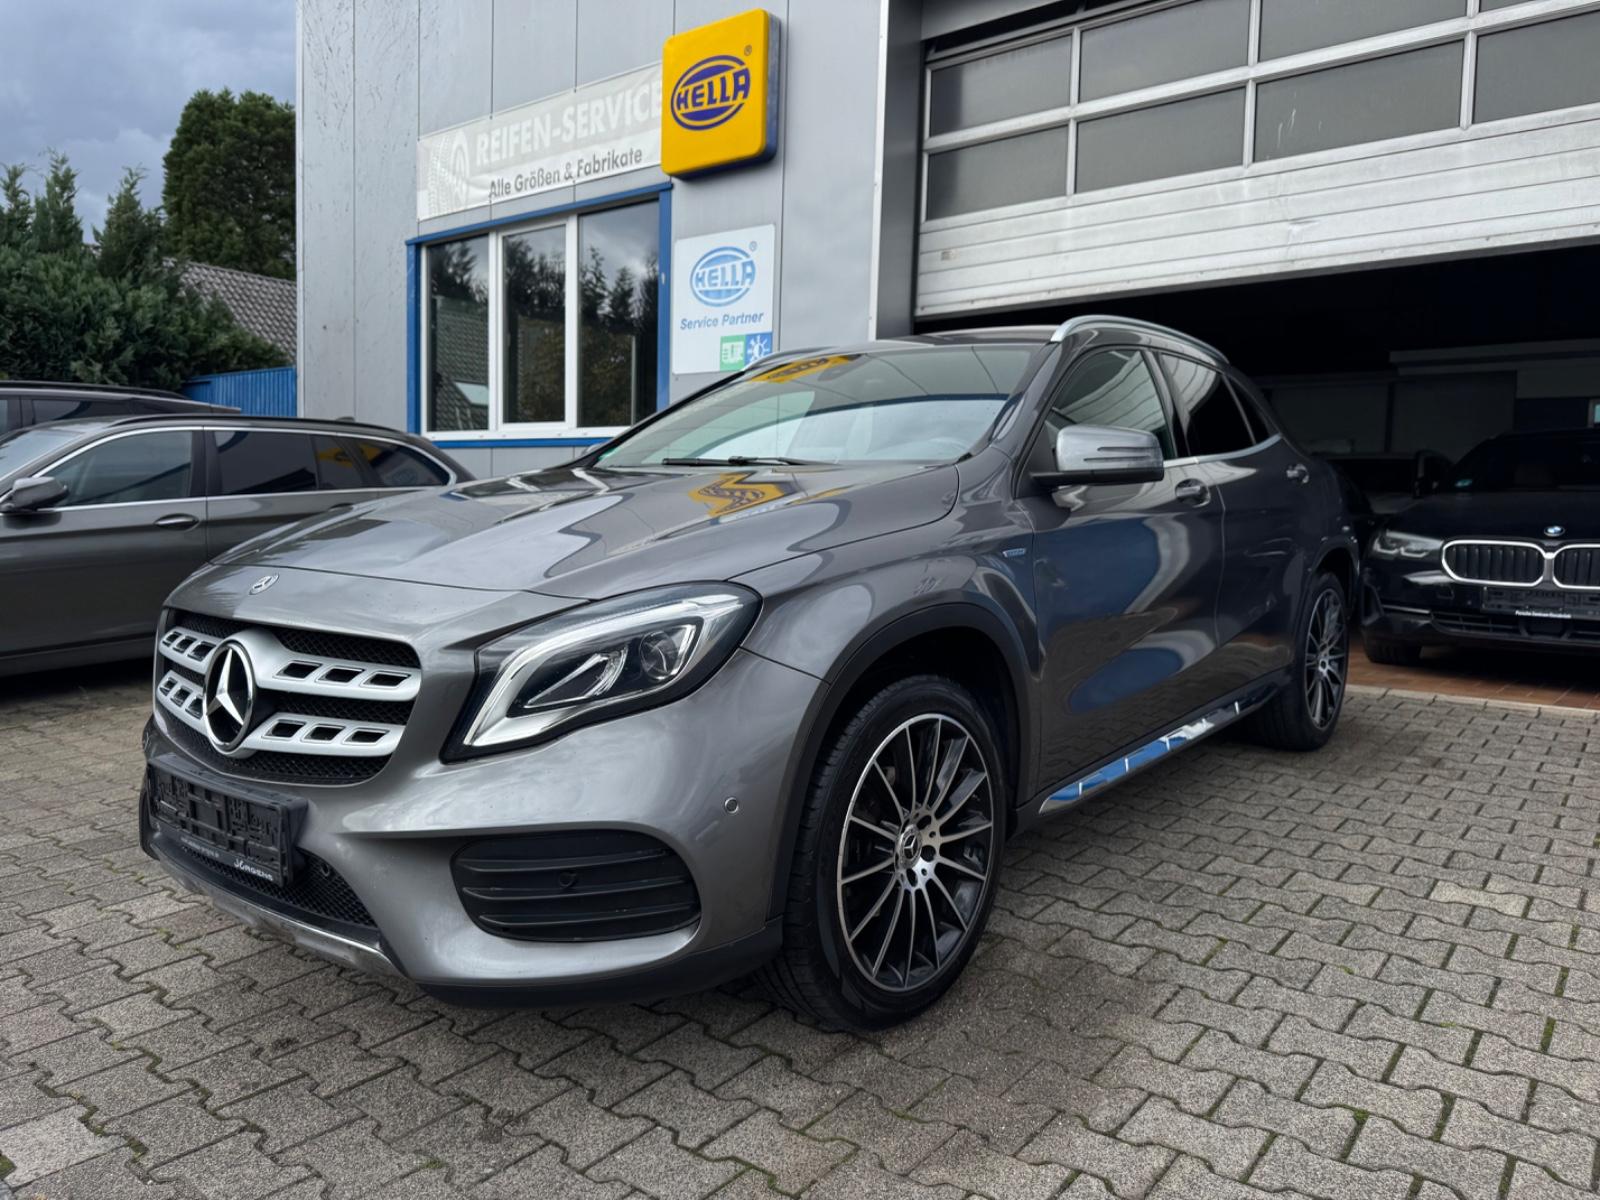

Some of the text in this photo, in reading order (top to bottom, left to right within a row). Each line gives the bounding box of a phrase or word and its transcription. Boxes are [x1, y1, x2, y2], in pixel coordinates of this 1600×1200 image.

[677, 69, 750, 111] HELLA
[476, 79, 661, 167] REIFEN-SERVICE
[489, 148, 642, 198] Alle Größen & Fabrikate
[694, 259, 756, 289] HELLA
[680, 312, 764, 330] Service Partner
